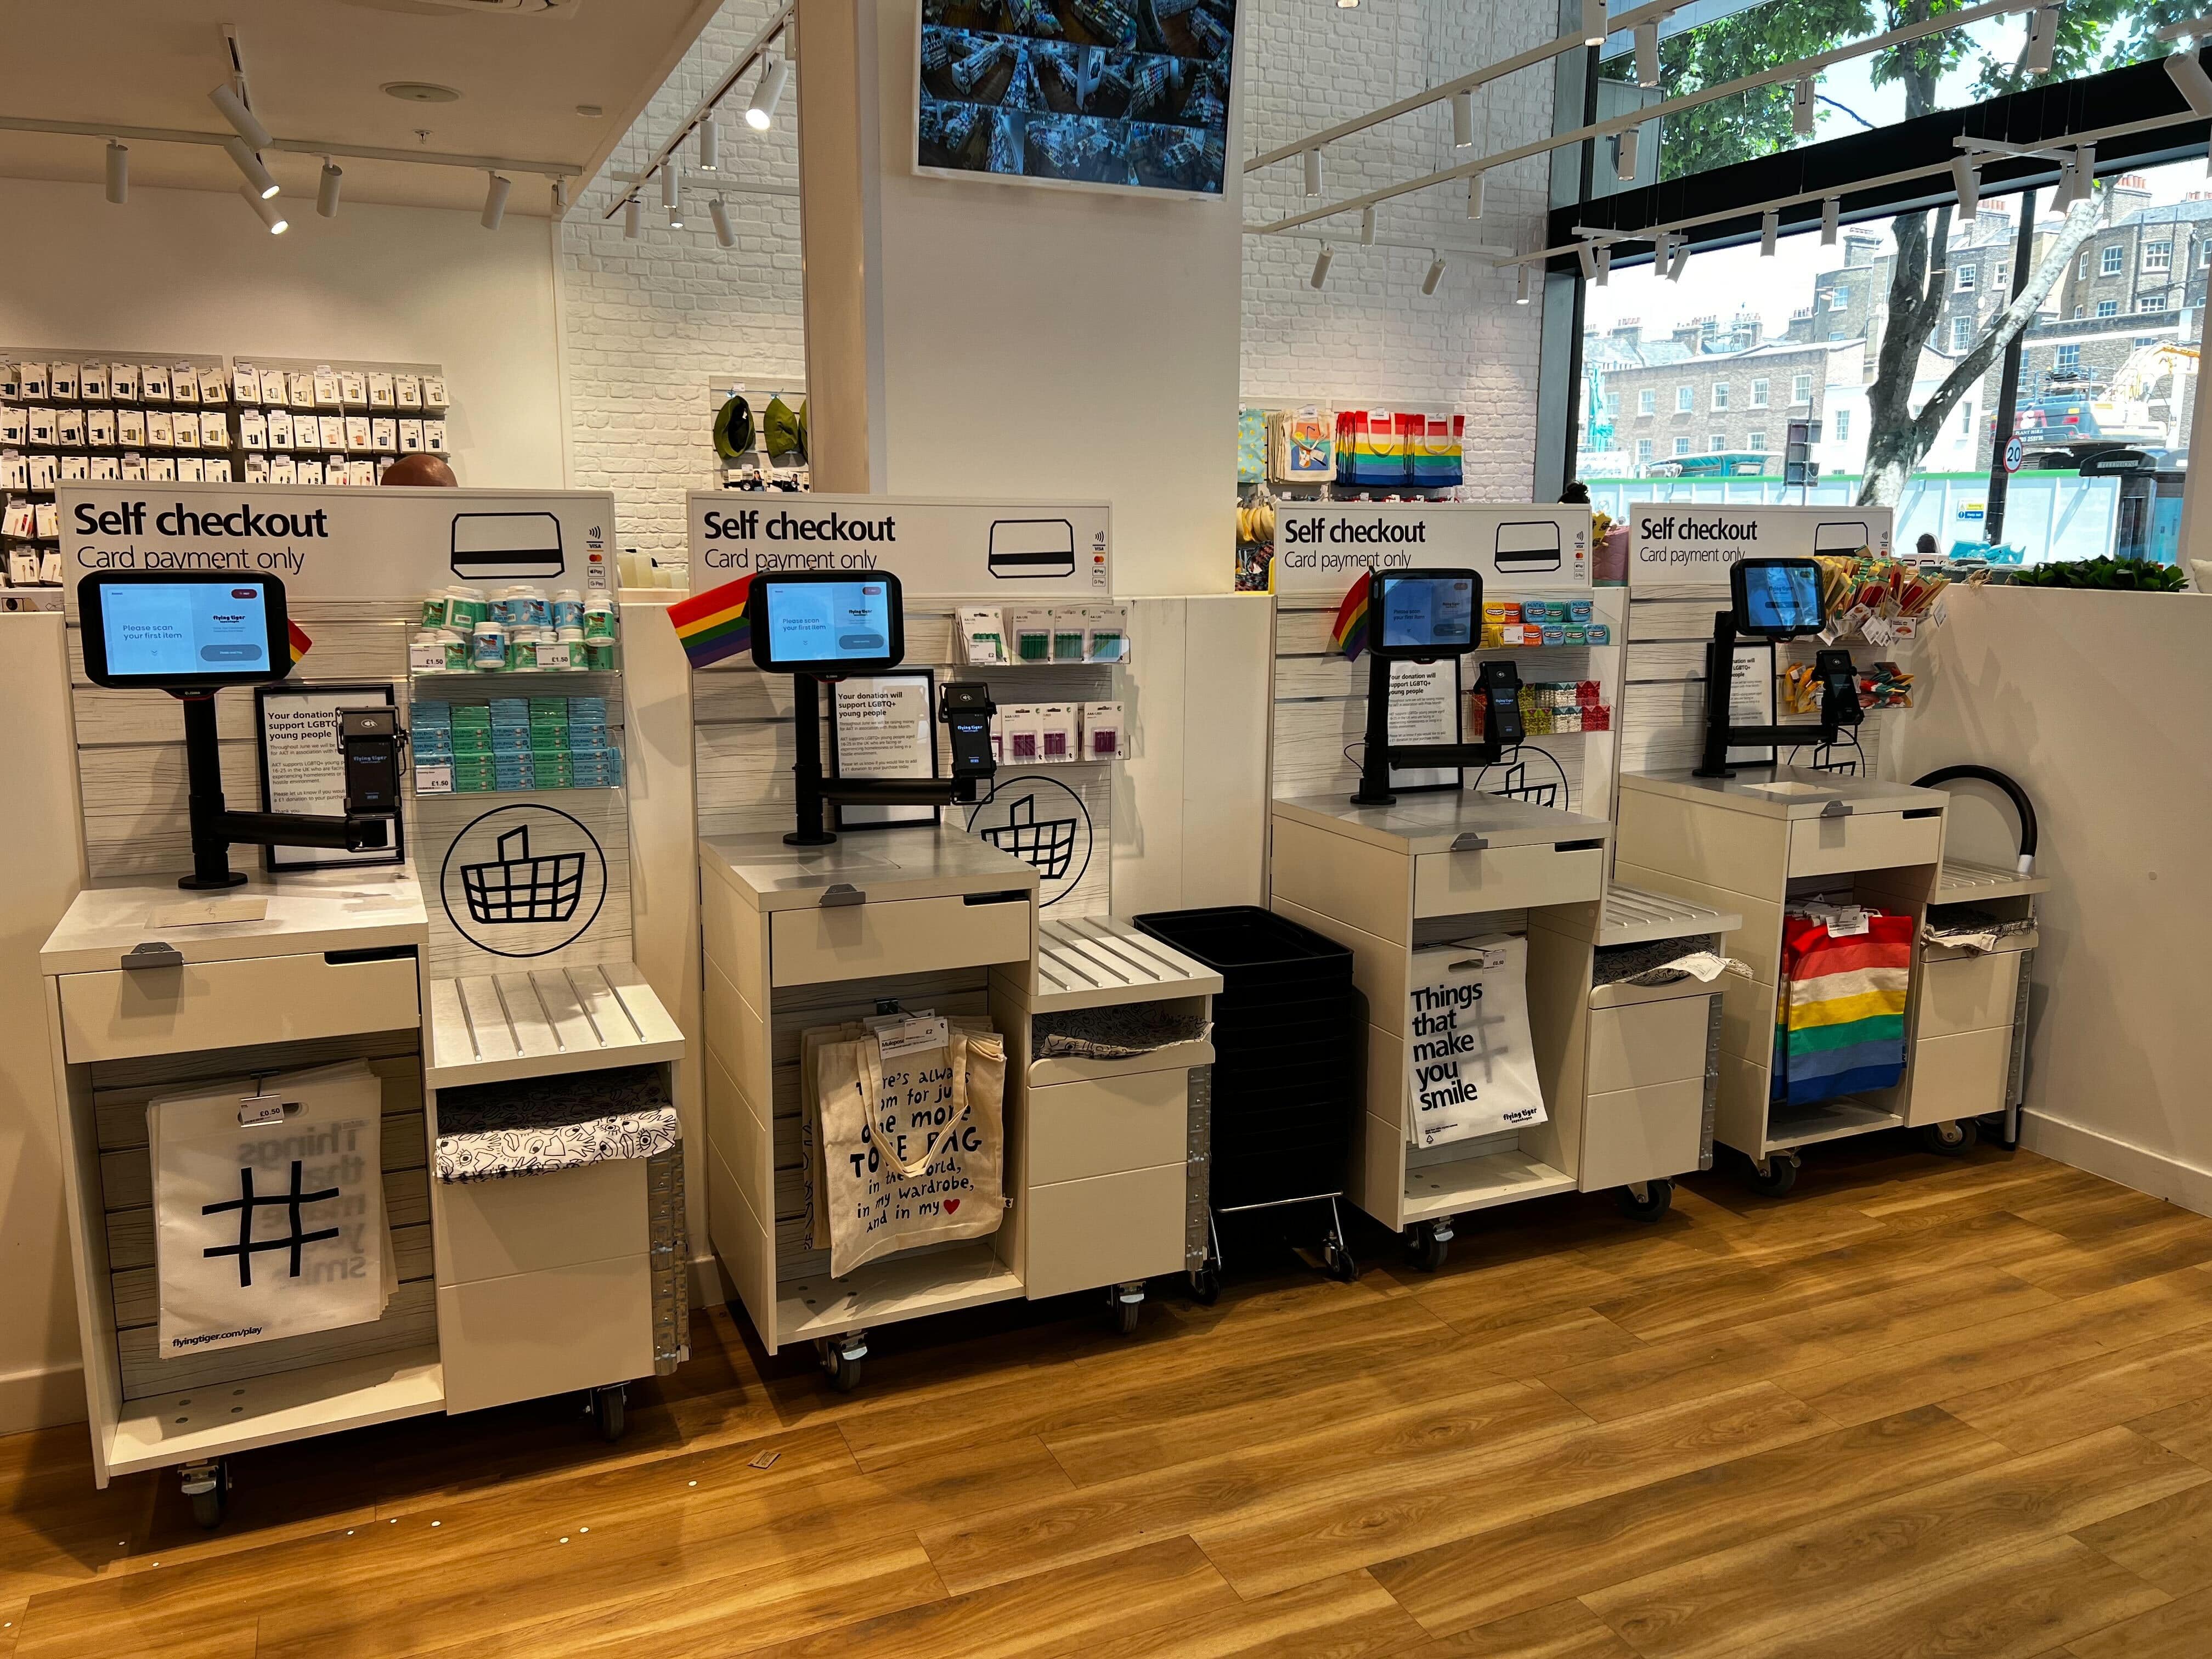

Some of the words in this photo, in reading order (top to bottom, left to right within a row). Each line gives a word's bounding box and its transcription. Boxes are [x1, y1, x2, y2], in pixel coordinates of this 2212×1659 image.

[2007, 447, 2021, 462] 20
[74, 502, 146, 536] Self
[156, 503, 329, 538] checkout
[704, 510, 759, 540] Self
[765, 511, 895, 541] checkout
[1285, 517, 1325, 543] Self
[1329, 518, 1426, 543] checkout
[1641, 517, 1675, 540] Self
[1678, 517, 1758, 541] checkout
[77, 545, 134, 568] Card
[144, 549, 250, 569] payment
[257, 546, 305, 575] only
[705, 548, 749, 568] Card
[755, 551, 836, 571] payment
[840, 549, 877, 570] only
[1284, 549, 1317, 568] Card
[1321, 551, 1379, 572] payment
[1384, 549, 1411, 569] only
[1640, 546, 1666, 562] Card
[1670, 547, 1719, 566] payment
[1722, 546, 1745, 561] only
[269, 721, 304, 731] support
[863, 709, 887, 718] people
[269, 733, 298, 741] young
[301, 730, 331, 740] people
[1410, 983, 1483, 1012] Things
[1412, 1008, 1457, 1037] that
[1413, 1031, 1474, 1062] make
[856, 1072, 910, 1096] Tre's
[918, 1066, 971, 1085] alwas
[1416, 1060, 1458, 1092] you
[907, 1088, 929, 1106] for
[1420, 1079, 1478, 1111] smile
[259, 1108, 280, 1117] £0.50
[1503, 1111, 1522, 1121] flying
[1522, 1108, 1537, 1117] tiger
[850, 1133, 908, 1178] TOE
[868, 1178, 881, 1195] in
[885, 1170, 905, 1184] the
[923, 1156, 962, 1178] orld,
[857, 1202, 870, 1219] in
[875, 1195, 890, 1209] my
[898, 1176, 975, 1199] wardrobe,
[866, 1212, 888, 1234] and
[895, 1206, 910, 1220] in
[919, 1200, 940, 1217] my
[172, 1325, 263, 1348] flyingtiger.com/play
